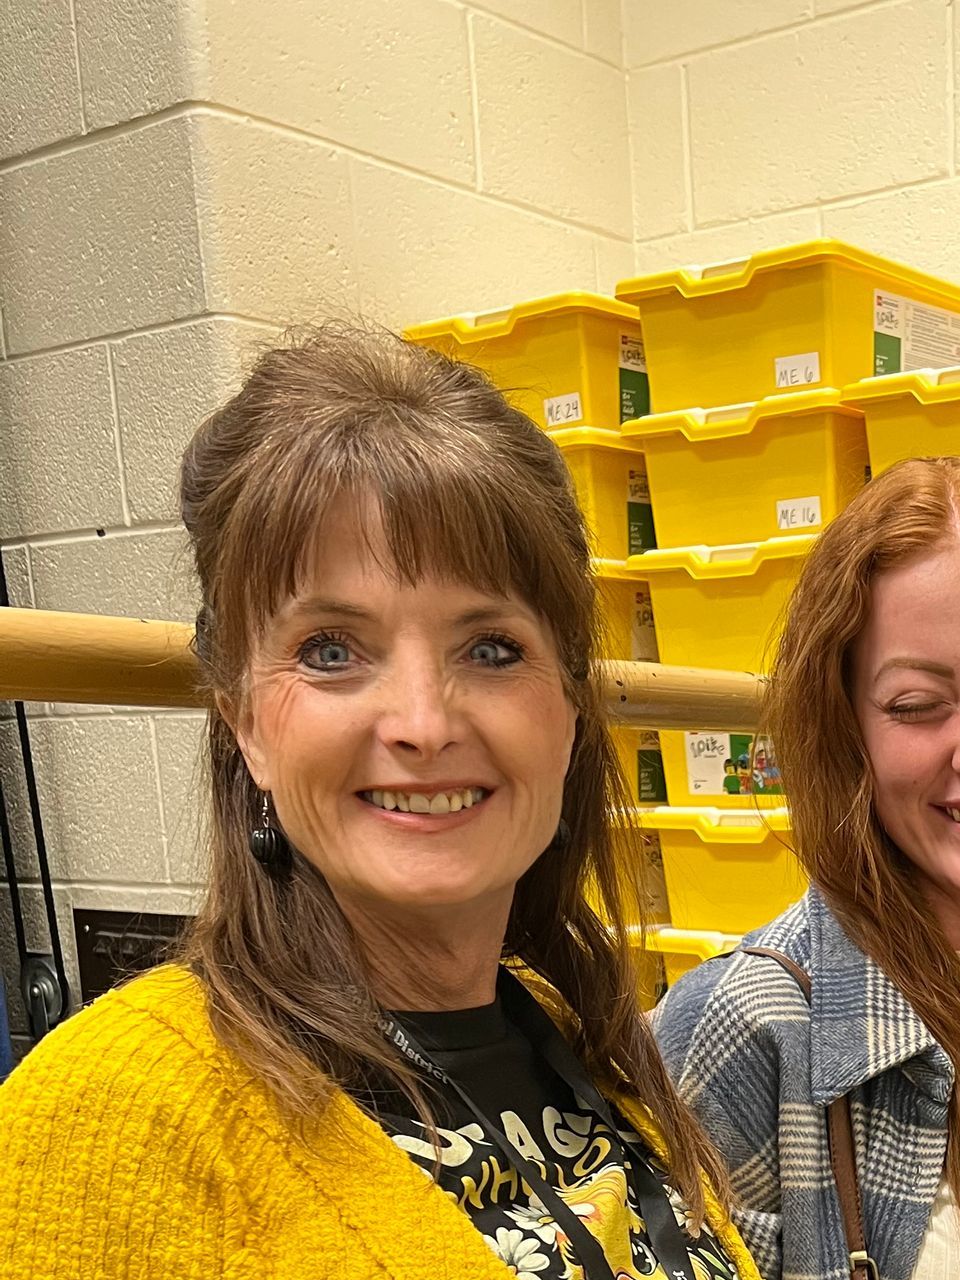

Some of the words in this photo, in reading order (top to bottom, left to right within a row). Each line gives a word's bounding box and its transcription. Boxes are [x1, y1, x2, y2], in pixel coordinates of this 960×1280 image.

[778, 368, 799, 386] ME
[804, 366, 814, 383] 6
[566, 401, 578, 418] 24
[778, 508, 796, 528] ME
[802, 507, 815, 524] 16
[690, 737, 724, 758] spike
